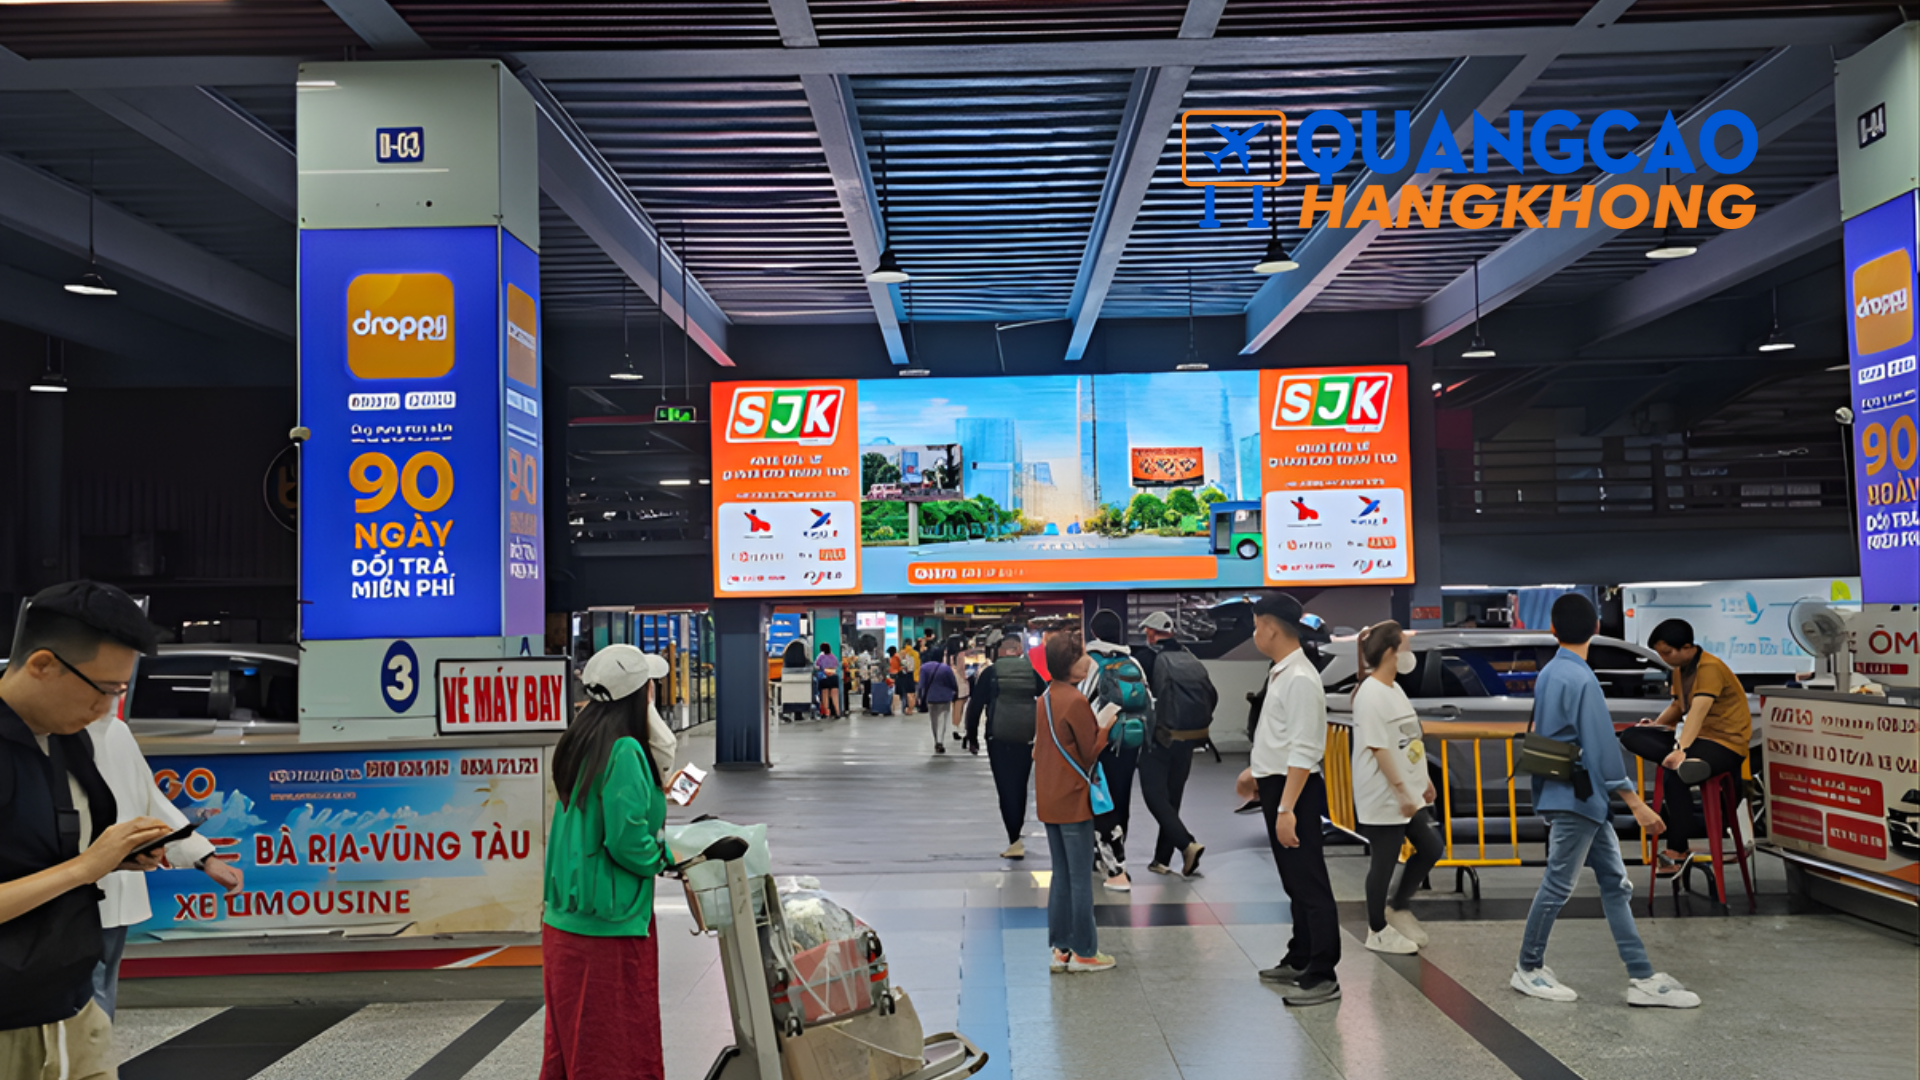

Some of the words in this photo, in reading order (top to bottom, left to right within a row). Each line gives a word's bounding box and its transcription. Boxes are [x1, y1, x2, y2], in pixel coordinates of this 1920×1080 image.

[734, 394, 838, 434] SJK
[1280, 380, 1386, 422] SJK
[1862, 414, 1918, 476] 90
[349, 451, 454, 513] 90
[354, 513, 454, 549] NGÀY
[416, 573, 456, 597] PHÍ
[386, 654, 414, 701] 3
[442, 665, 470, 724] VÉ
[473, 665, 519, 723] MÁY
[524, 674, 563, 723] BAY
[253, 824, 299, 866] BÀ
[470, 821, 531, 861] TÀU
